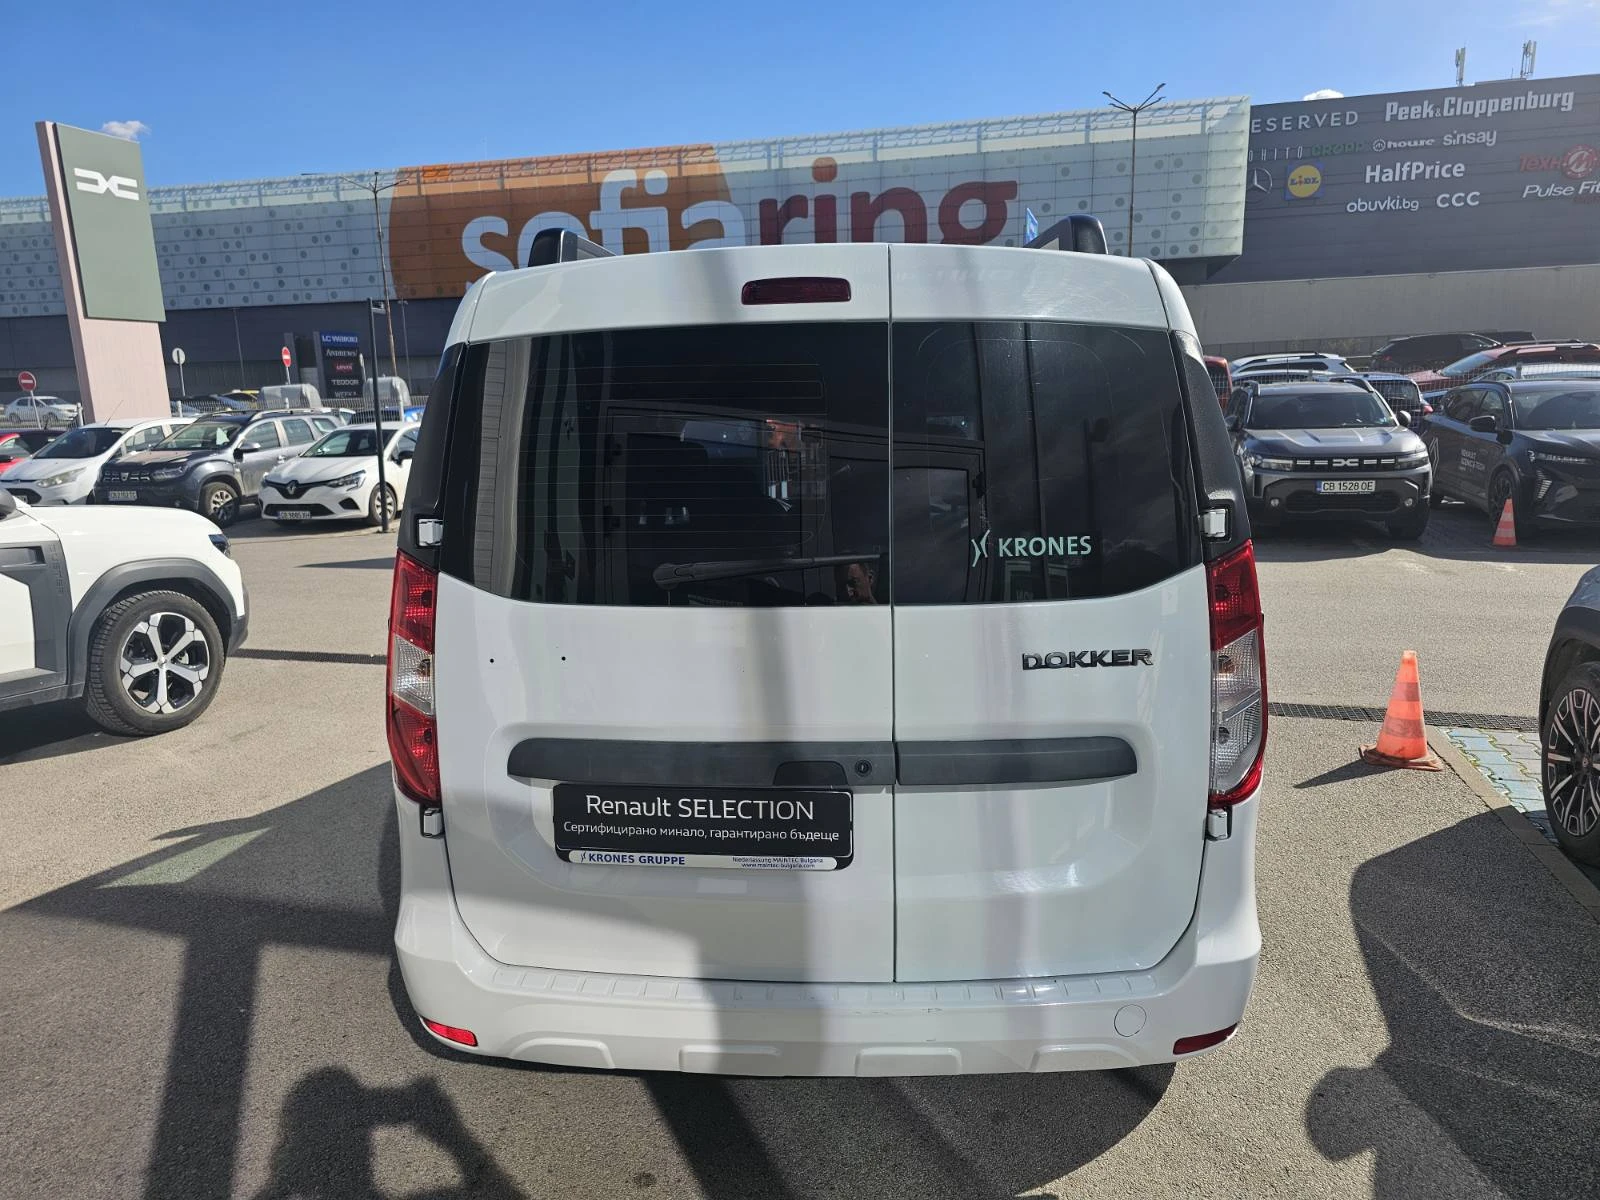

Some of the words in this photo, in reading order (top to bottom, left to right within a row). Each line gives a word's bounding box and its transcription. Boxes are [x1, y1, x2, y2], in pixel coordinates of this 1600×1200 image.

[1365, 161, 1465, 184] HalfPrice
[1436, 192, 1481, 208] CCC
[1522, 183, 1575, 198] Pulse
[1346, 195, 1419, 213] obuvki.bg
[1339, 482, 1359, 491] 1528
[999, 536, 1092, 557] KRONES
[1022, 649, 1153, 670] DOKKER
[586, 795, 671, 817] Renault
[678, 798, 814, 820] SELECTION
[563, 821, 657, 836] Сертифицирано
[660, 828, 707, 839] минало,
[710, 829, 787, 841] гарантирано
[790, 829, 839, 842] бъдеще
[588, 853, 635, 864] KRONES
[638, 854, 685, 865] GRUPPE
